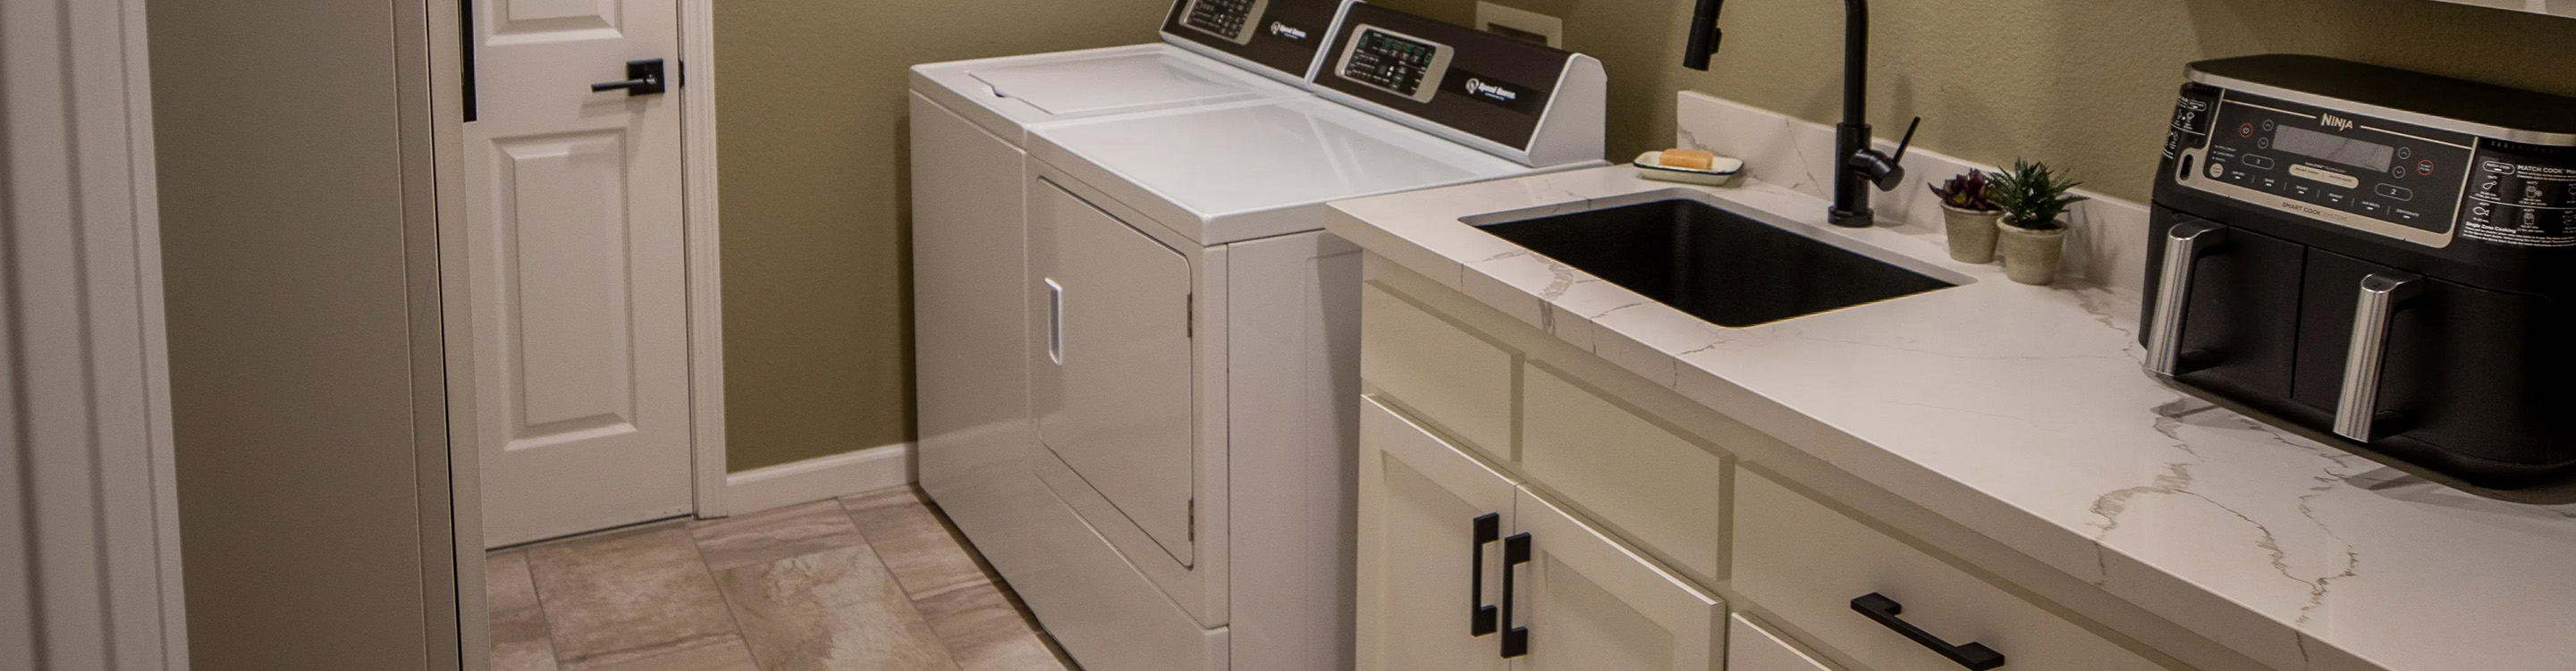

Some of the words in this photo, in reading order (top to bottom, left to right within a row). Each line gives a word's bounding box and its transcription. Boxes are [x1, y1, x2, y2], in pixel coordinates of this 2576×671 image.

[1478, 82, 1498, 92] Speed
[1496, 87, 1516, 99] Queen
[2320, 113, 2353, 132] NINJA
[2517, 164, 2542, 172] MATCH
[2282, 202, 2302, 211] SMART
[2303, 206, 2322, 216] COOK
[2323, 212, 2347, 222] SYSTEM
[2495, 226, 2517, 234] Cooking
